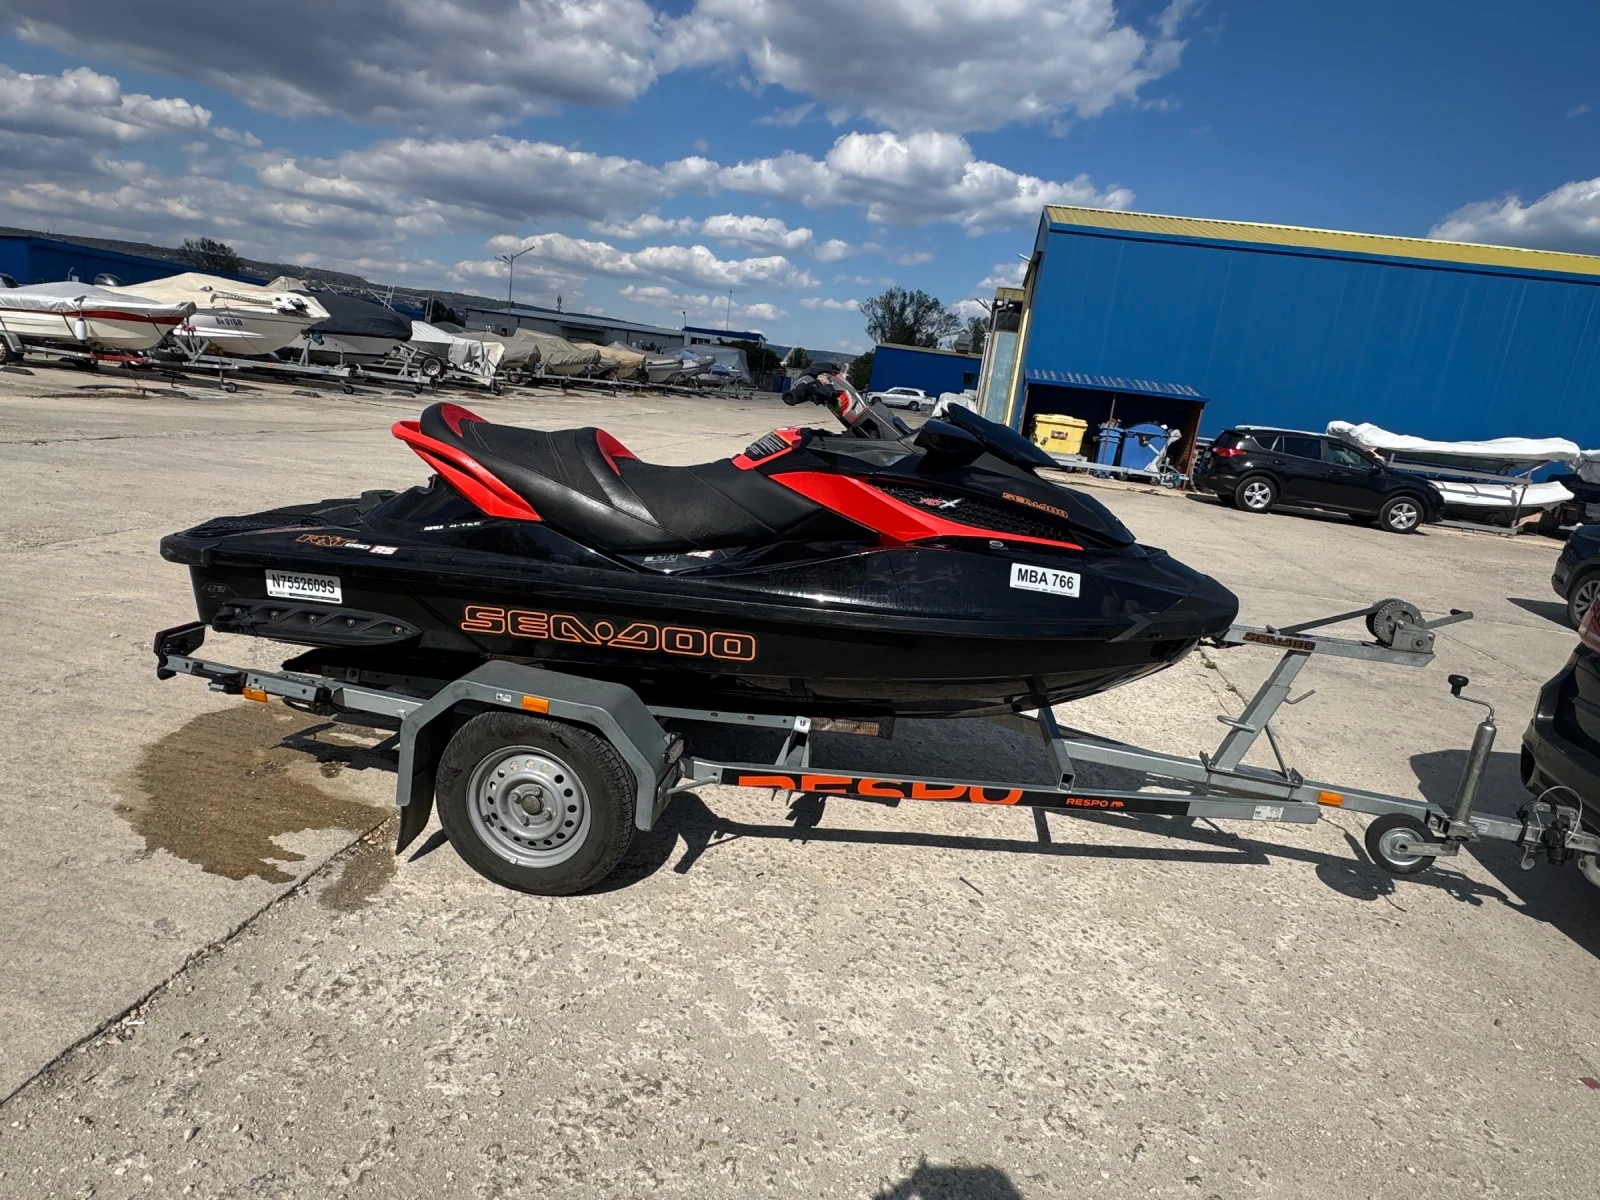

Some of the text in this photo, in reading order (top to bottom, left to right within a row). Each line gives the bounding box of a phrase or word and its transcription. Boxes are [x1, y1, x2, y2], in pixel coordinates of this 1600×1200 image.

[271, 574, 335, 594] N7552609S
[1017, 568, 1048, 586] MBA
[1052, 573, 1074, 590] 766
[1065, 797, 1109, 808] RESPO
